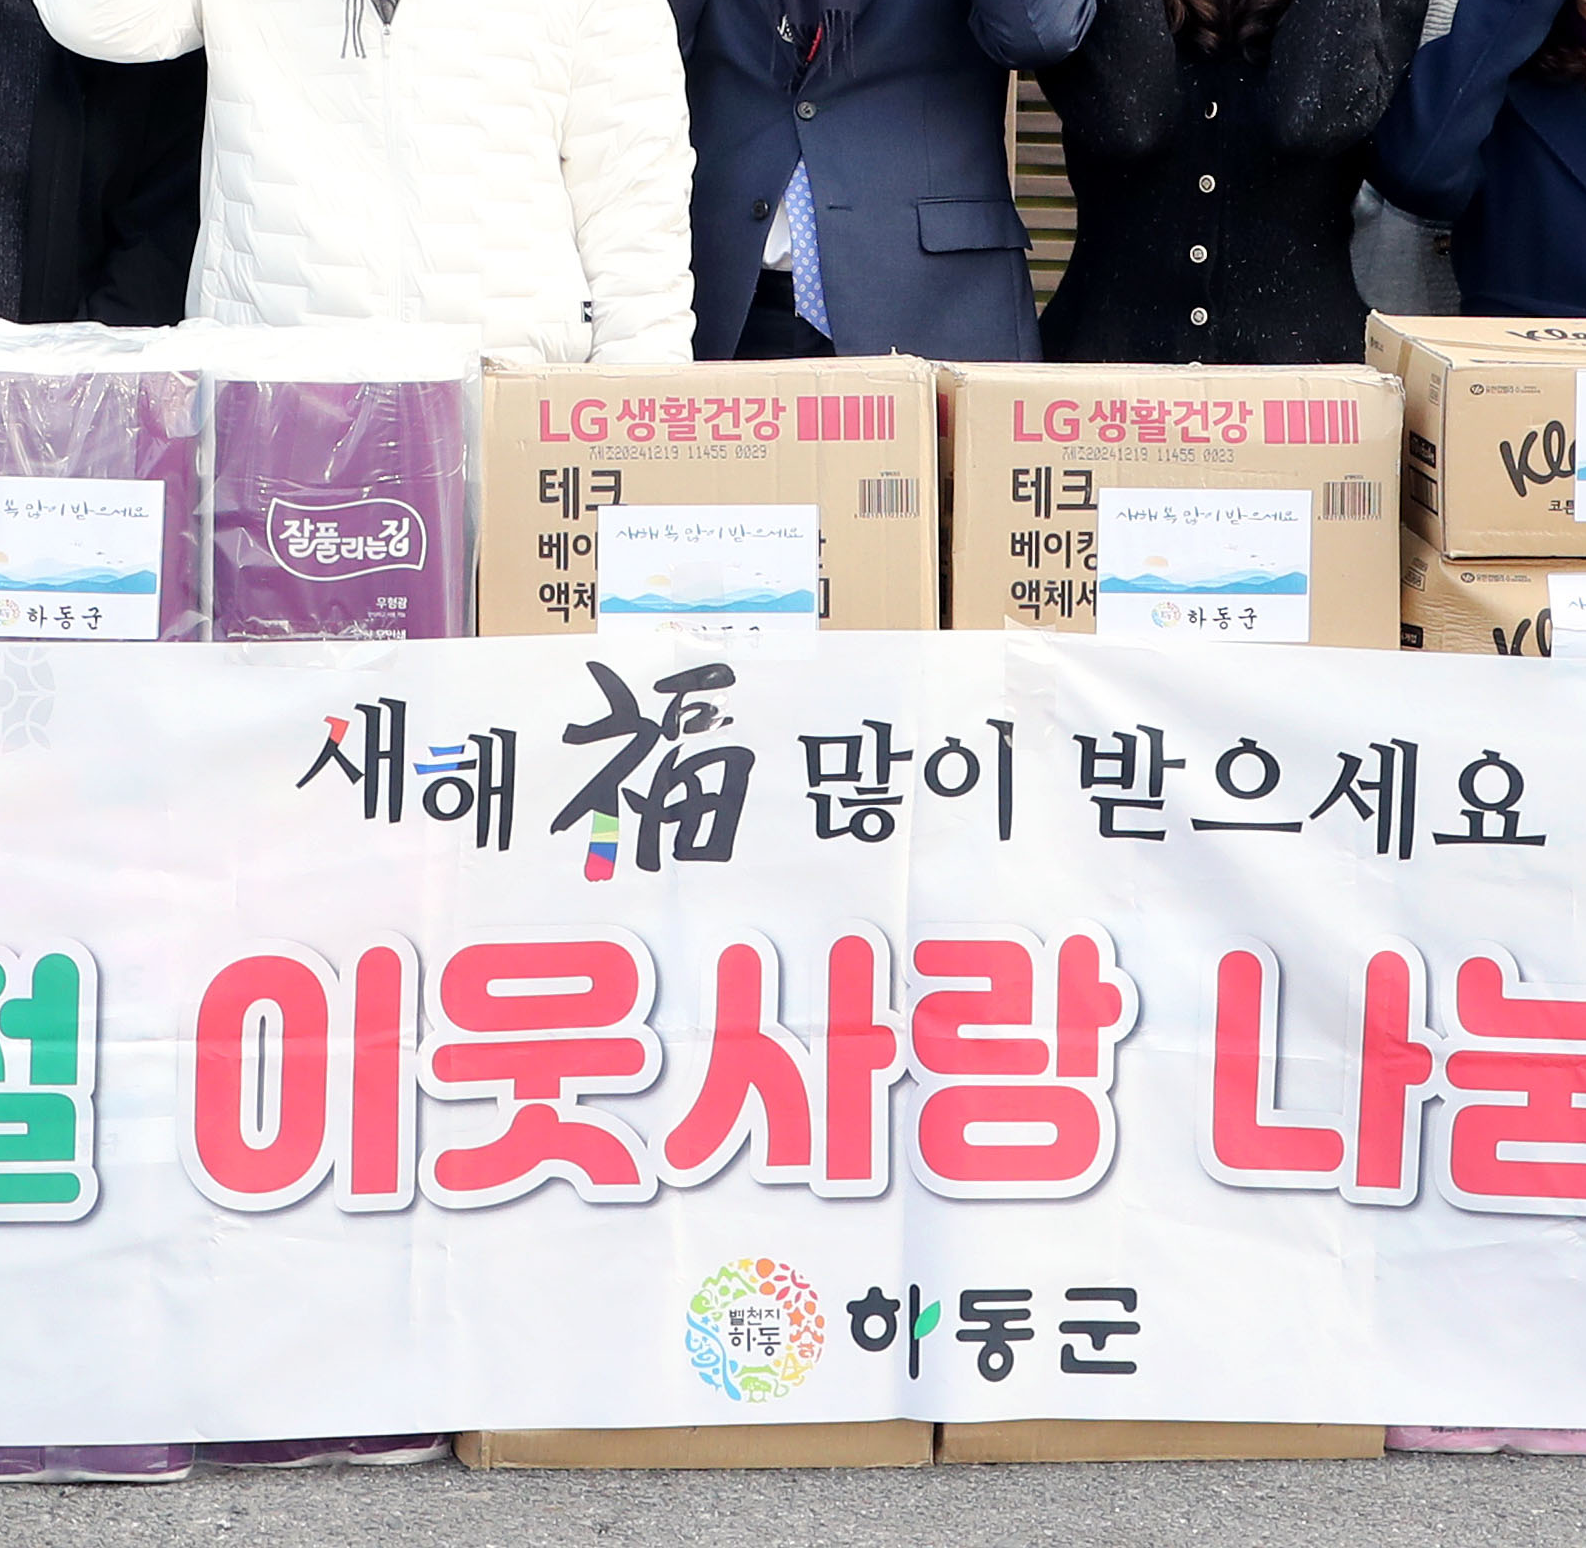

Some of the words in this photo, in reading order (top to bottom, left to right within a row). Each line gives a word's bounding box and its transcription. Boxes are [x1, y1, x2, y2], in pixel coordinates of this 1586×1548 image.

[539, 399, 609, 443] LG
[614, 394, 788, 443] 생활건강
[1012, 399, 1081, 445] LG
[1087, 398, 1254, 445] 생활건강
[4, 498, 19, 518] 복
[70, 500, 151, 521] 받으세요
[539, 466, 628, 521] 테크
[1011, 466, 1097, 520] 테크
[1116, 507, 1159, 523] 새해
[1163, 506, 1177, 524] 복
[1225, 506, 1301, 526] 받으세요
[279, 517, 411, 565] 잘풀리는집
[538, 531, 598, 571] 베이
[615, 526, 659, 542] 새해
[664, 524, 679, 543] 복
[728, 525, 805, 544] 받으세요
[26, 604, 104, 631] 하동군
[1186, 606, 1259, 631] 하동군
[296, 697, 517, 852] 새해
[549, 659, 757, 883] 福
[797, 719, 1016, 845] 많이
[1073, 719, 1548, 860] 받으세요
[188, 930, 1124, 1202] 이웃사랑
[728, 1327, 781, 1357] 하동
[846, 1283, 1141, 1383] 하동군
